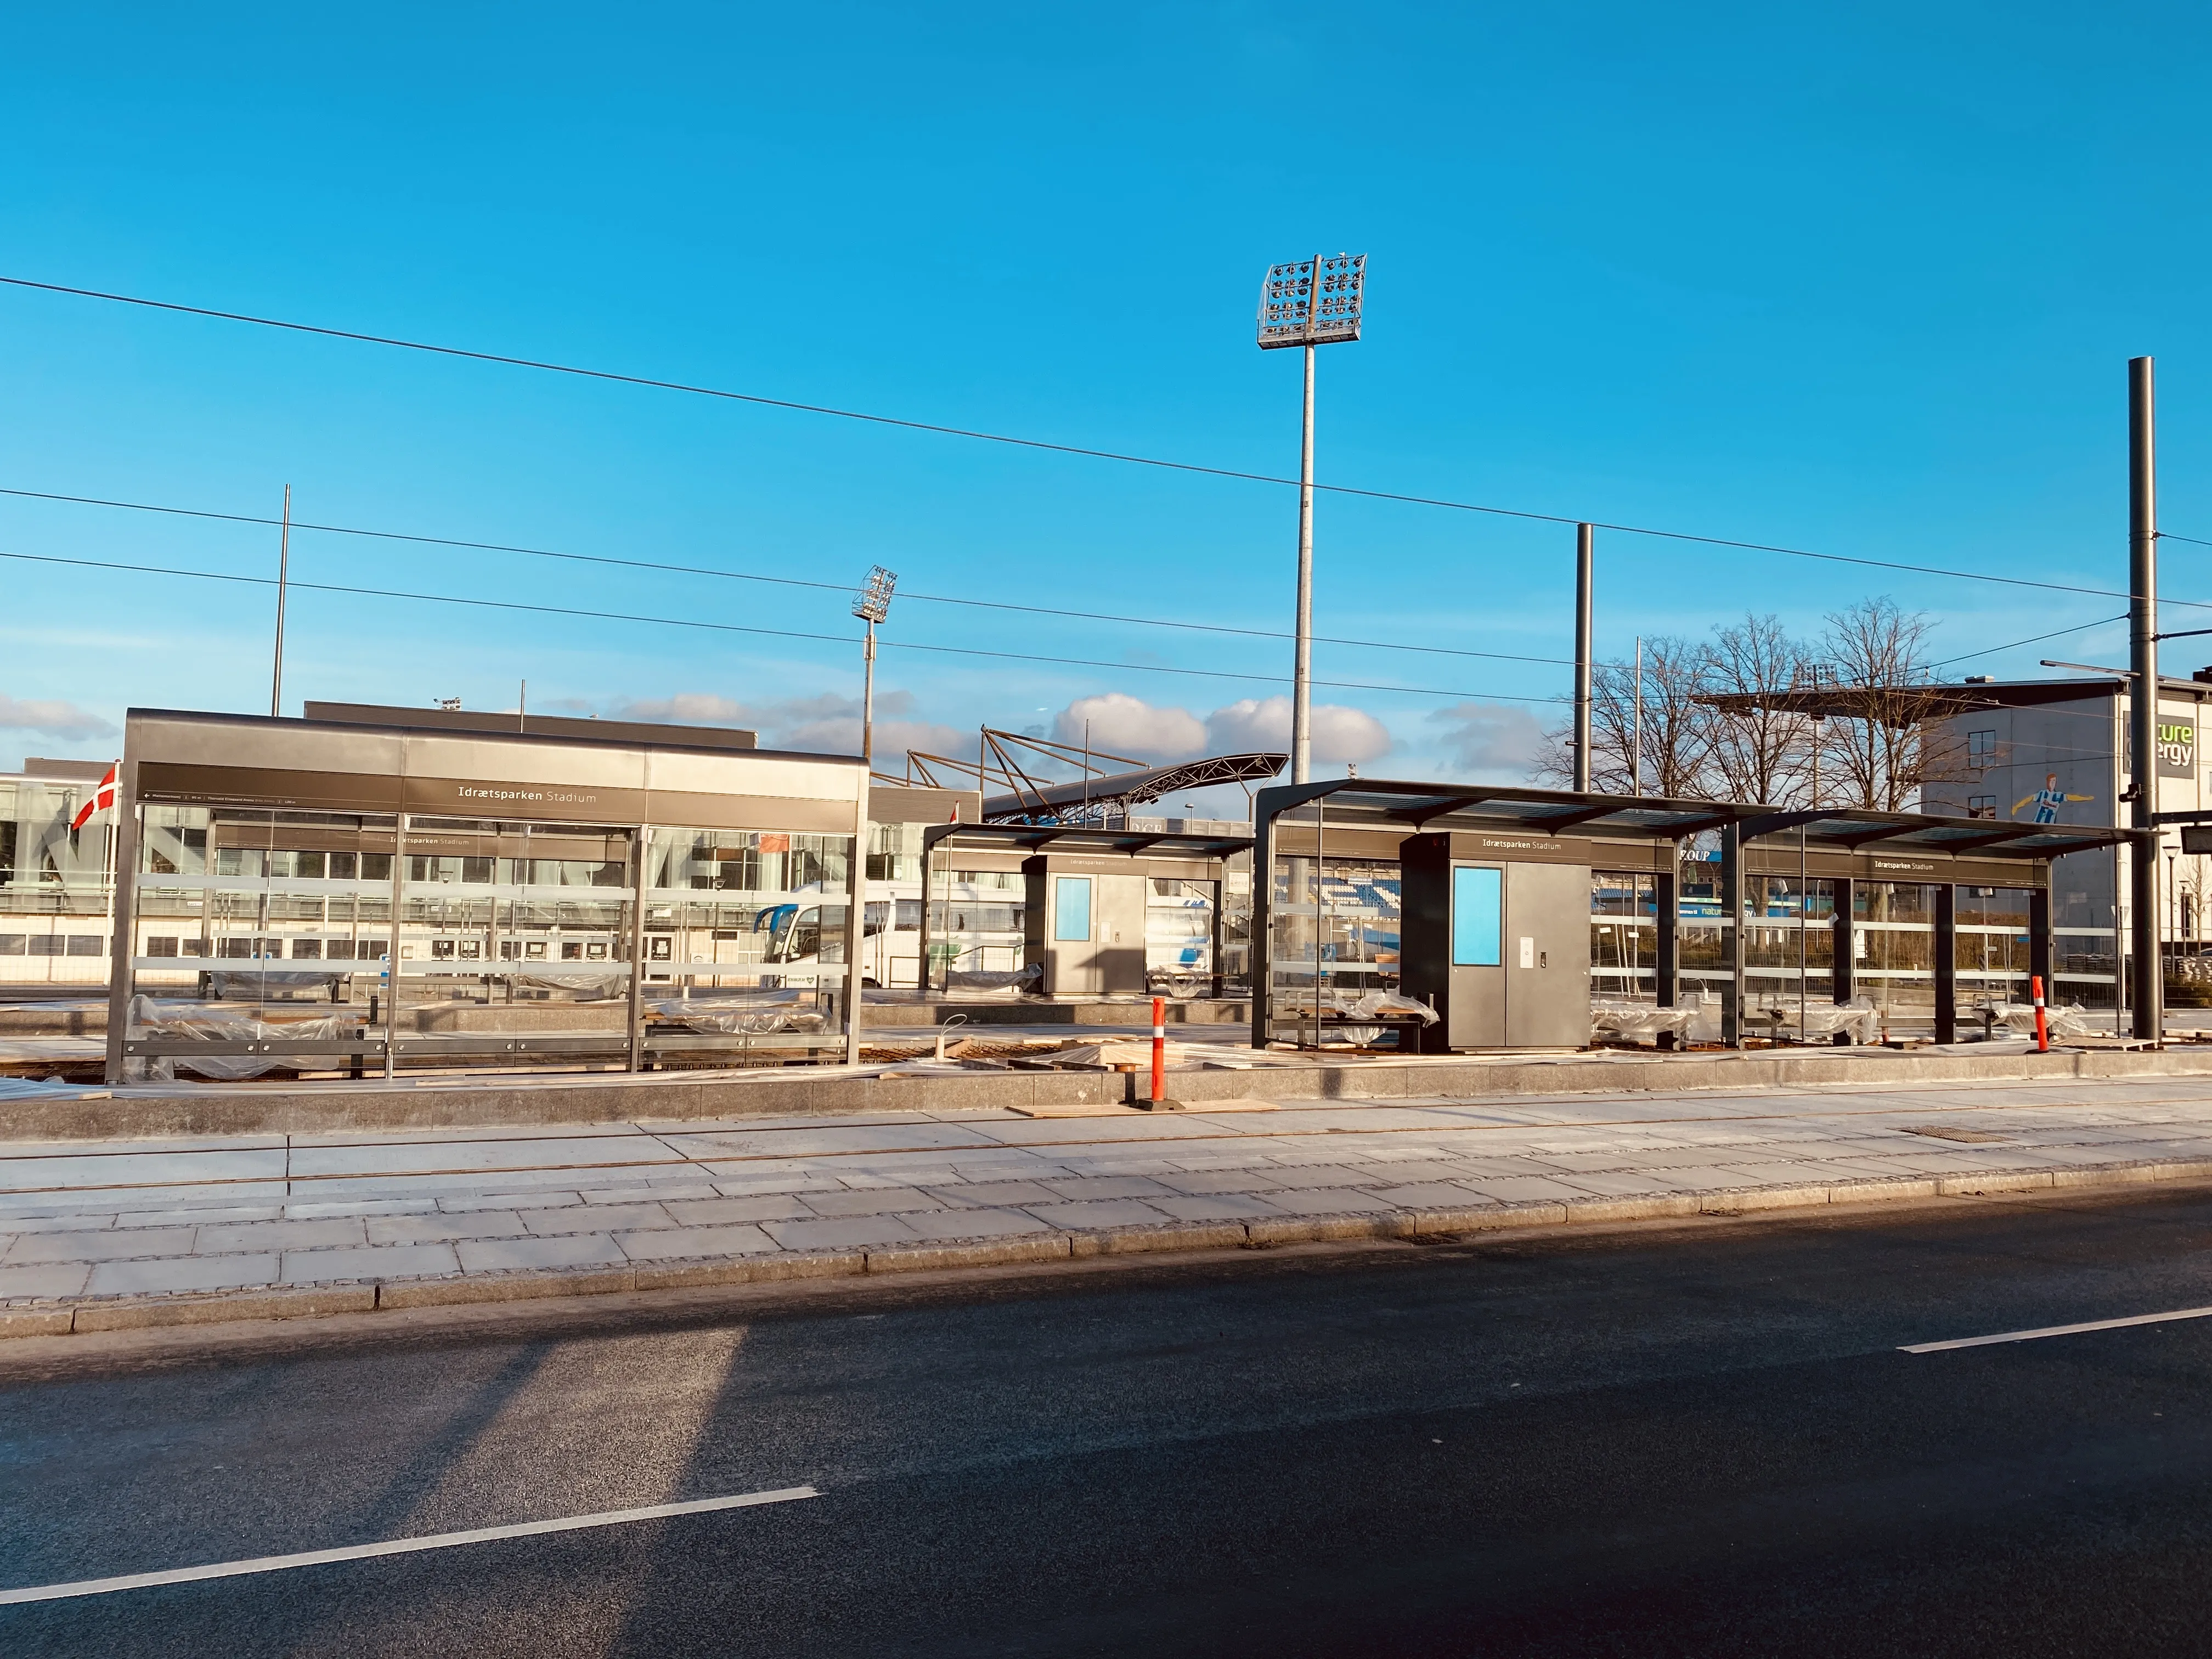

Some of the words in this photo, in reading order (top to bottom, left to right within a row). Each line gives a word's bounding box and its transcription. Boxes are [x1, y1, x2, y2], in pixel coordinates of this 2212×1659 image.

[458, 786, 543, 800] Idrætsparken
[546, 791, 597, 803] Stadium
[1482, 839, 1531, 849] Idrætsparken
[1532, 841, 1561, 850] Stadium
[1875, 860, 1911, 870] Idrætsparken
